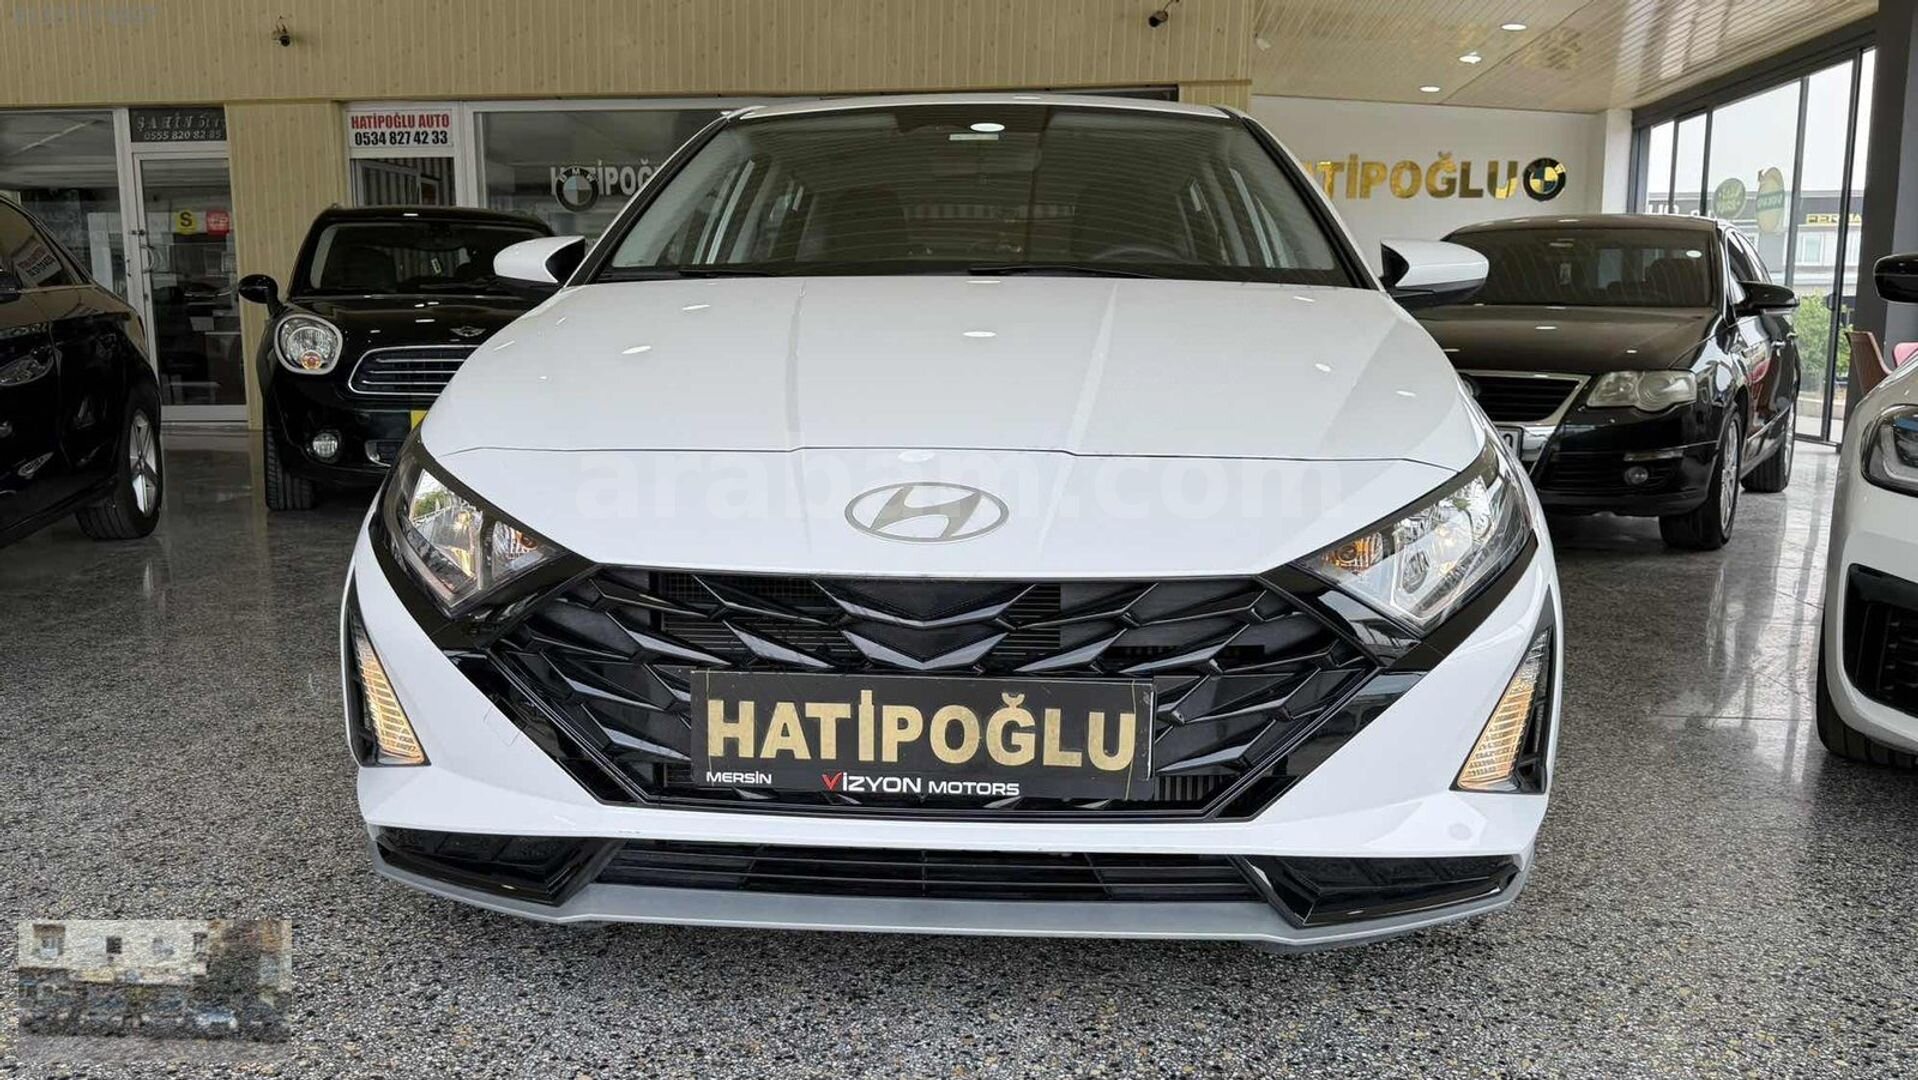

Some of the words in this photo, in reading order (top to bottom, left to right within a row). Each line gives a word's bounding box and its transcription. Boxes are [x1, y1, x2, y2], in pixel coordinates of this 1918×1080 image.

[351, 112, 415, 129] HATİPOĞLU
[418, 113, 450, 128] AUTO
[172, 130, 191, 140] 820
[354, 131, 386, 146] 0534
[389, 131, 411, 145] 827
[413, 130, 429, 144] 42
[431, 130, 448, 144] 33
[180, 211, 193, 228] S
[708, 689, 1137, 772] HATİPOĞLU
[706, 770, 772, 785] MERSİN
[822, 771, 922, 793] VİZYON
[927, 780, 1020, 796] MOTORS
